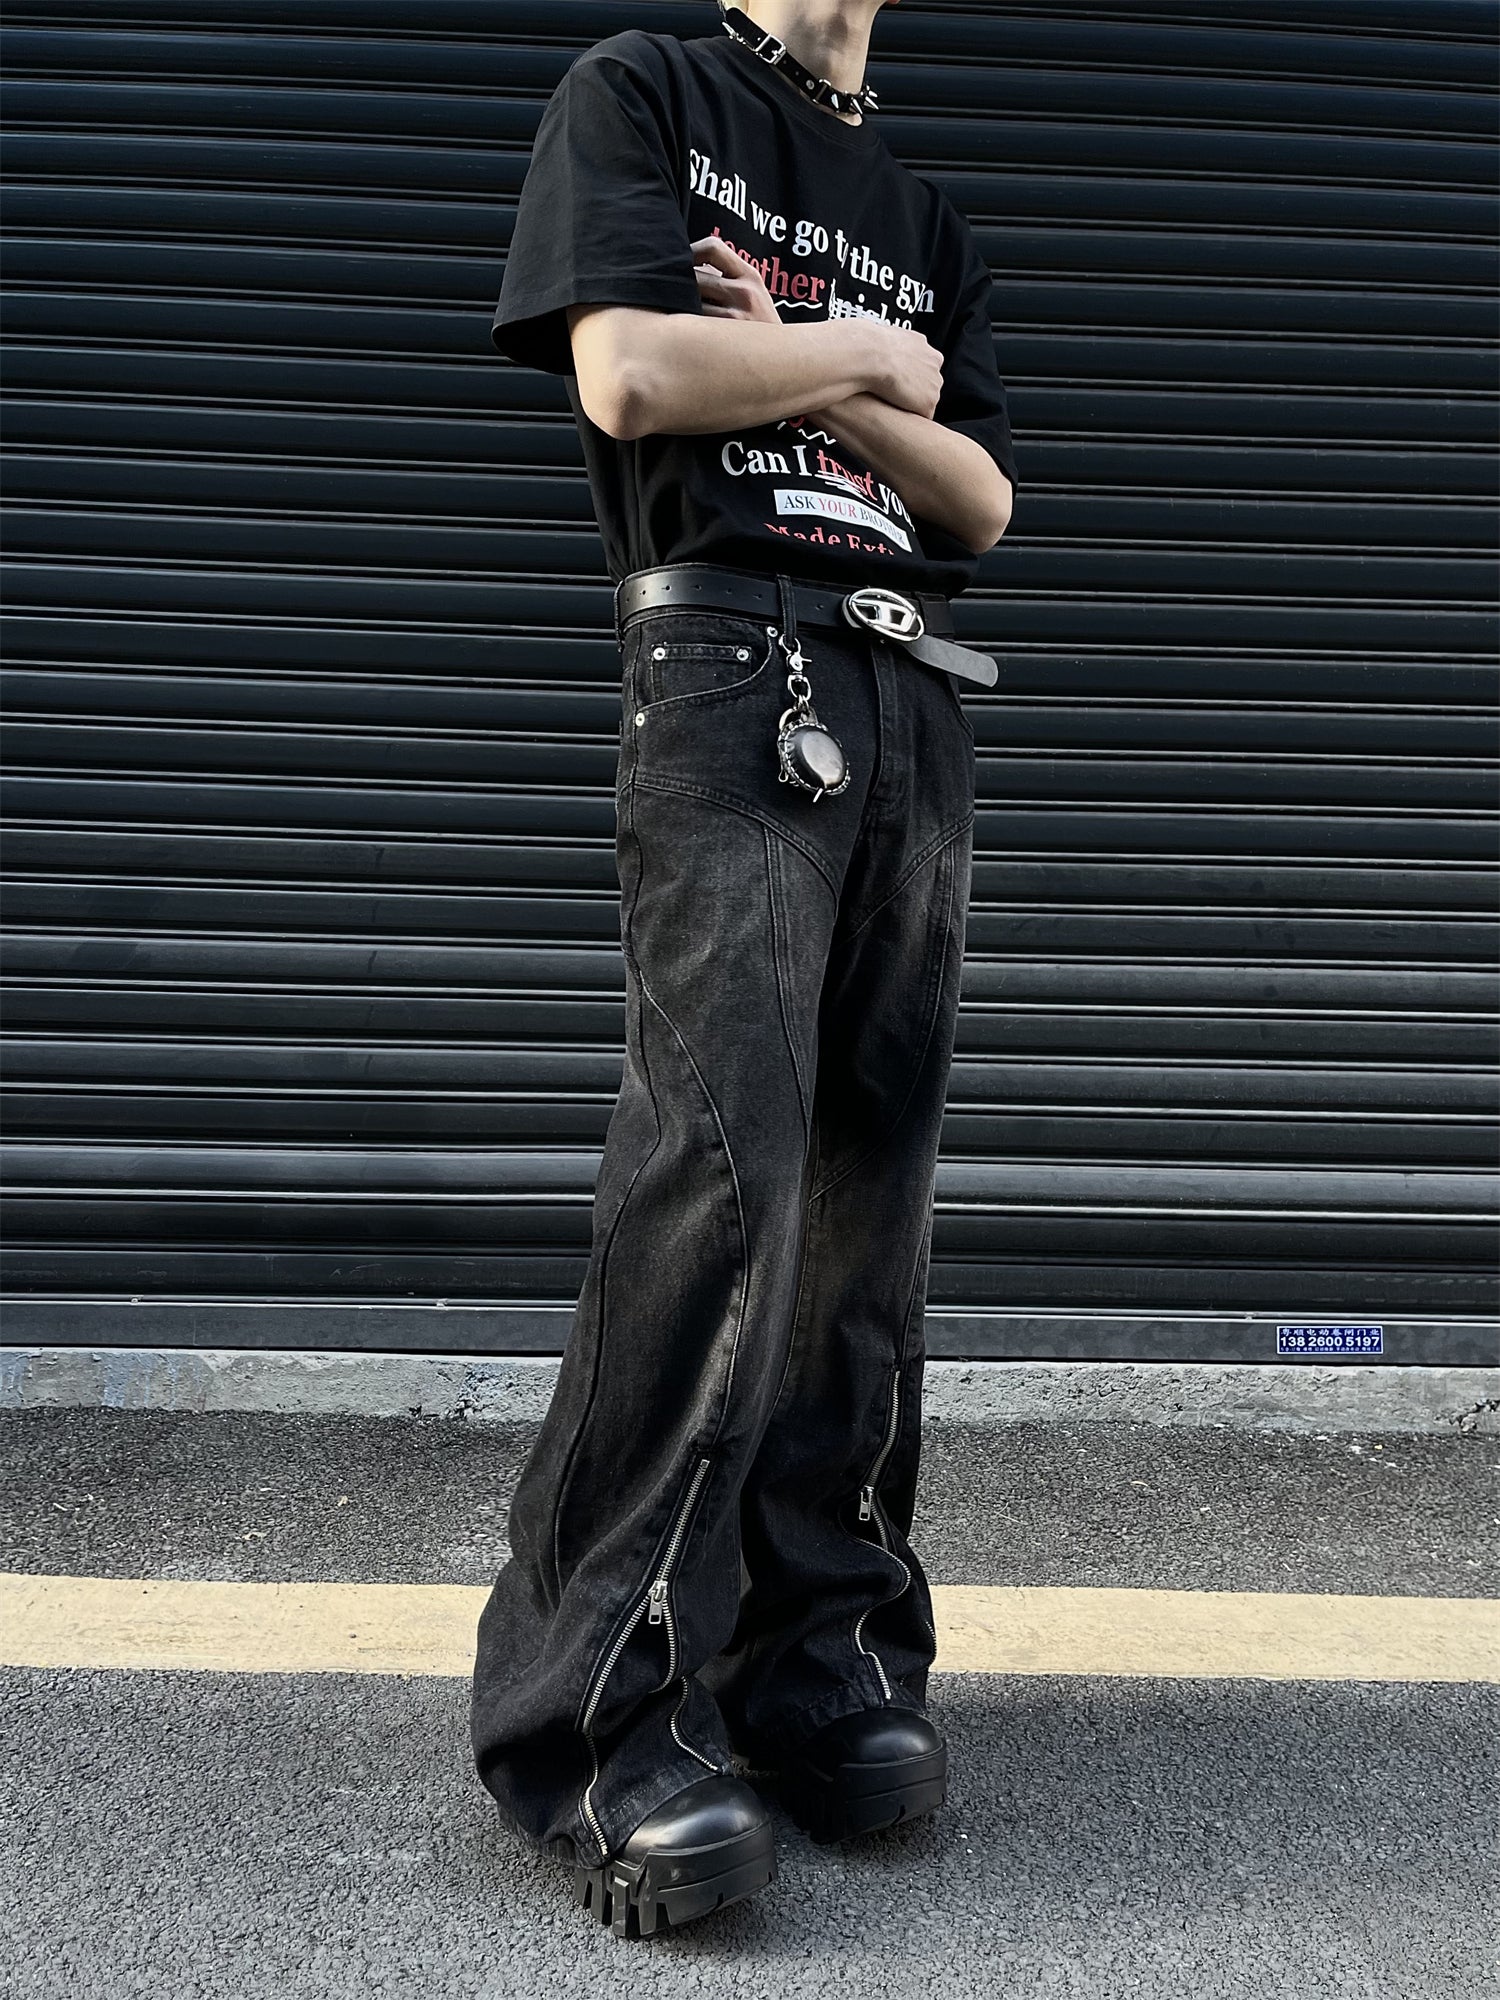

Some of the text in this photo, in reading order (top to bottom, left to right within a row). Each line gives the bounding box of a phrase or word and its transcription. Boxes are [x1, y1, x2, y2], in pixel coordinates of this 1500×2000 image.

[751, 201, 787, 242] we
[791, 220, 829, 257] go
[850, 246, 894, 291] the
[721, 441, 791, 477] Can
[792, 445, 813, 477] I
[816, 449, 878, 501] trust
[784, 495, 816, 510] ASK
[818, 498, 858, 518] YOUR
[1280, 1337, 1380, 1347] 138 2600 5197
